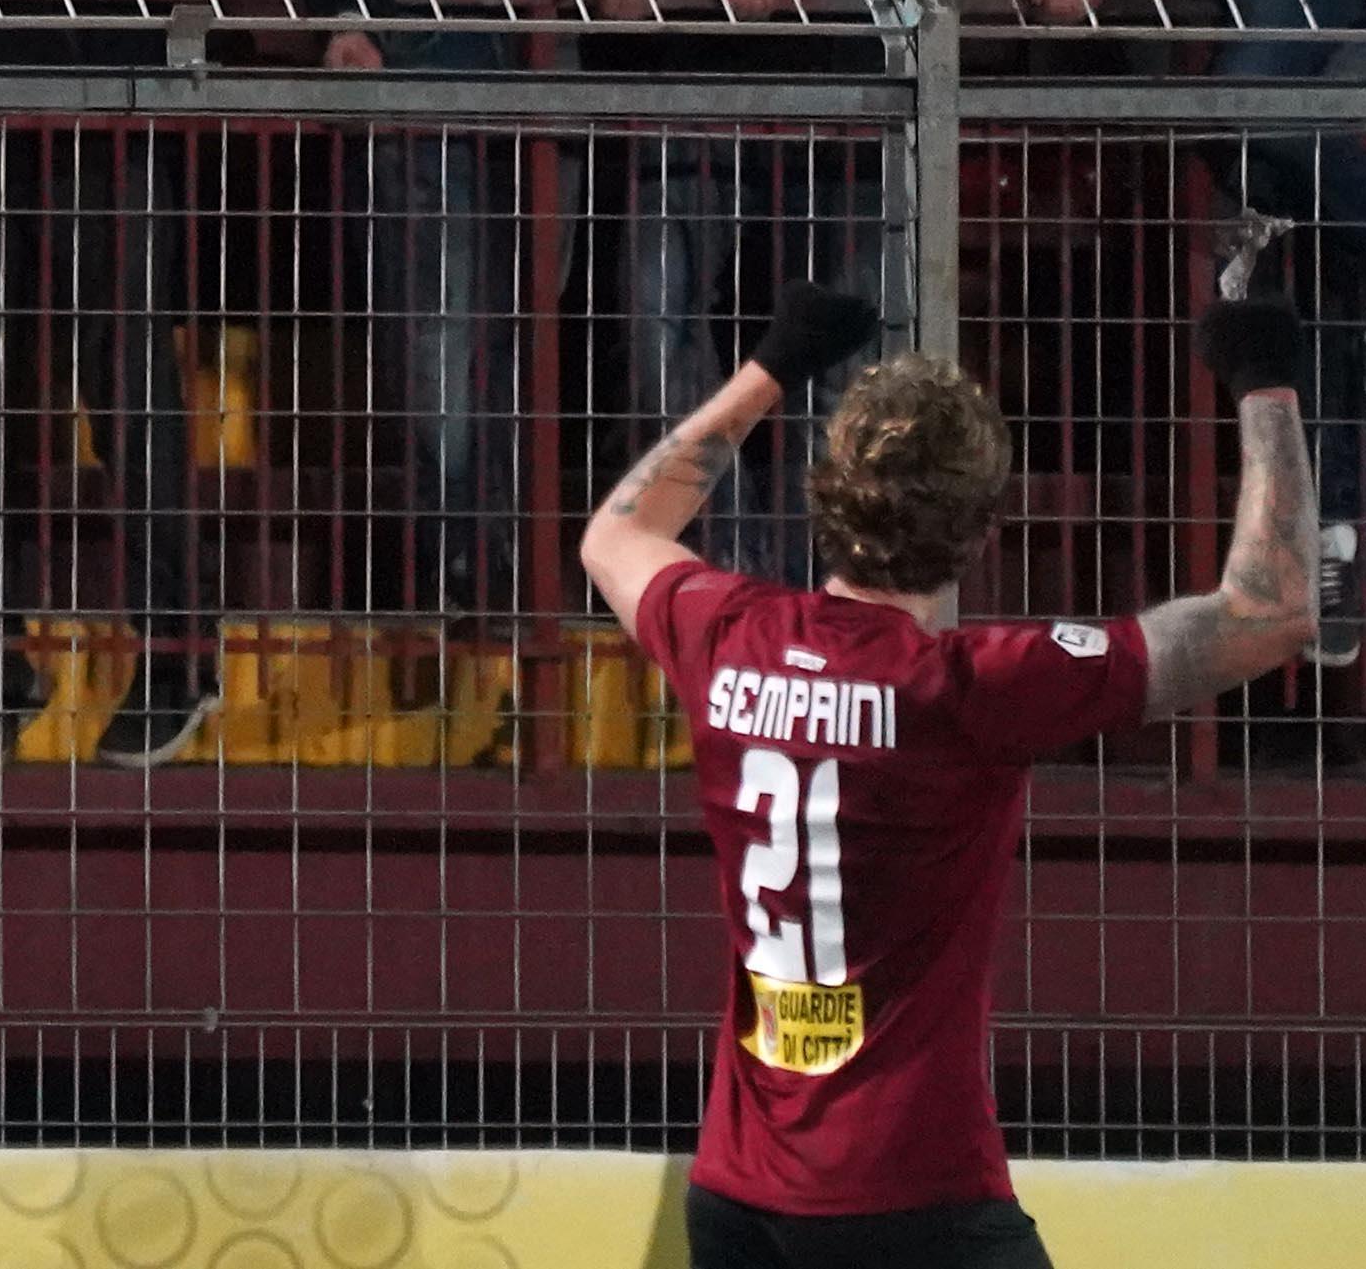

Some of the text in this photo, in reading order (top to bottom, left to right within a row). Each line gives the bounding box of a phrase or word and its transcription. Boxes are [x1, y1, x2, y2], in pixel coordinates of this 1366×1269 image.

[736, 748, 847, 987] 21
[779, 991, 857, 1025] GUARDIE
[783, 1034, 797, 1064] DI
